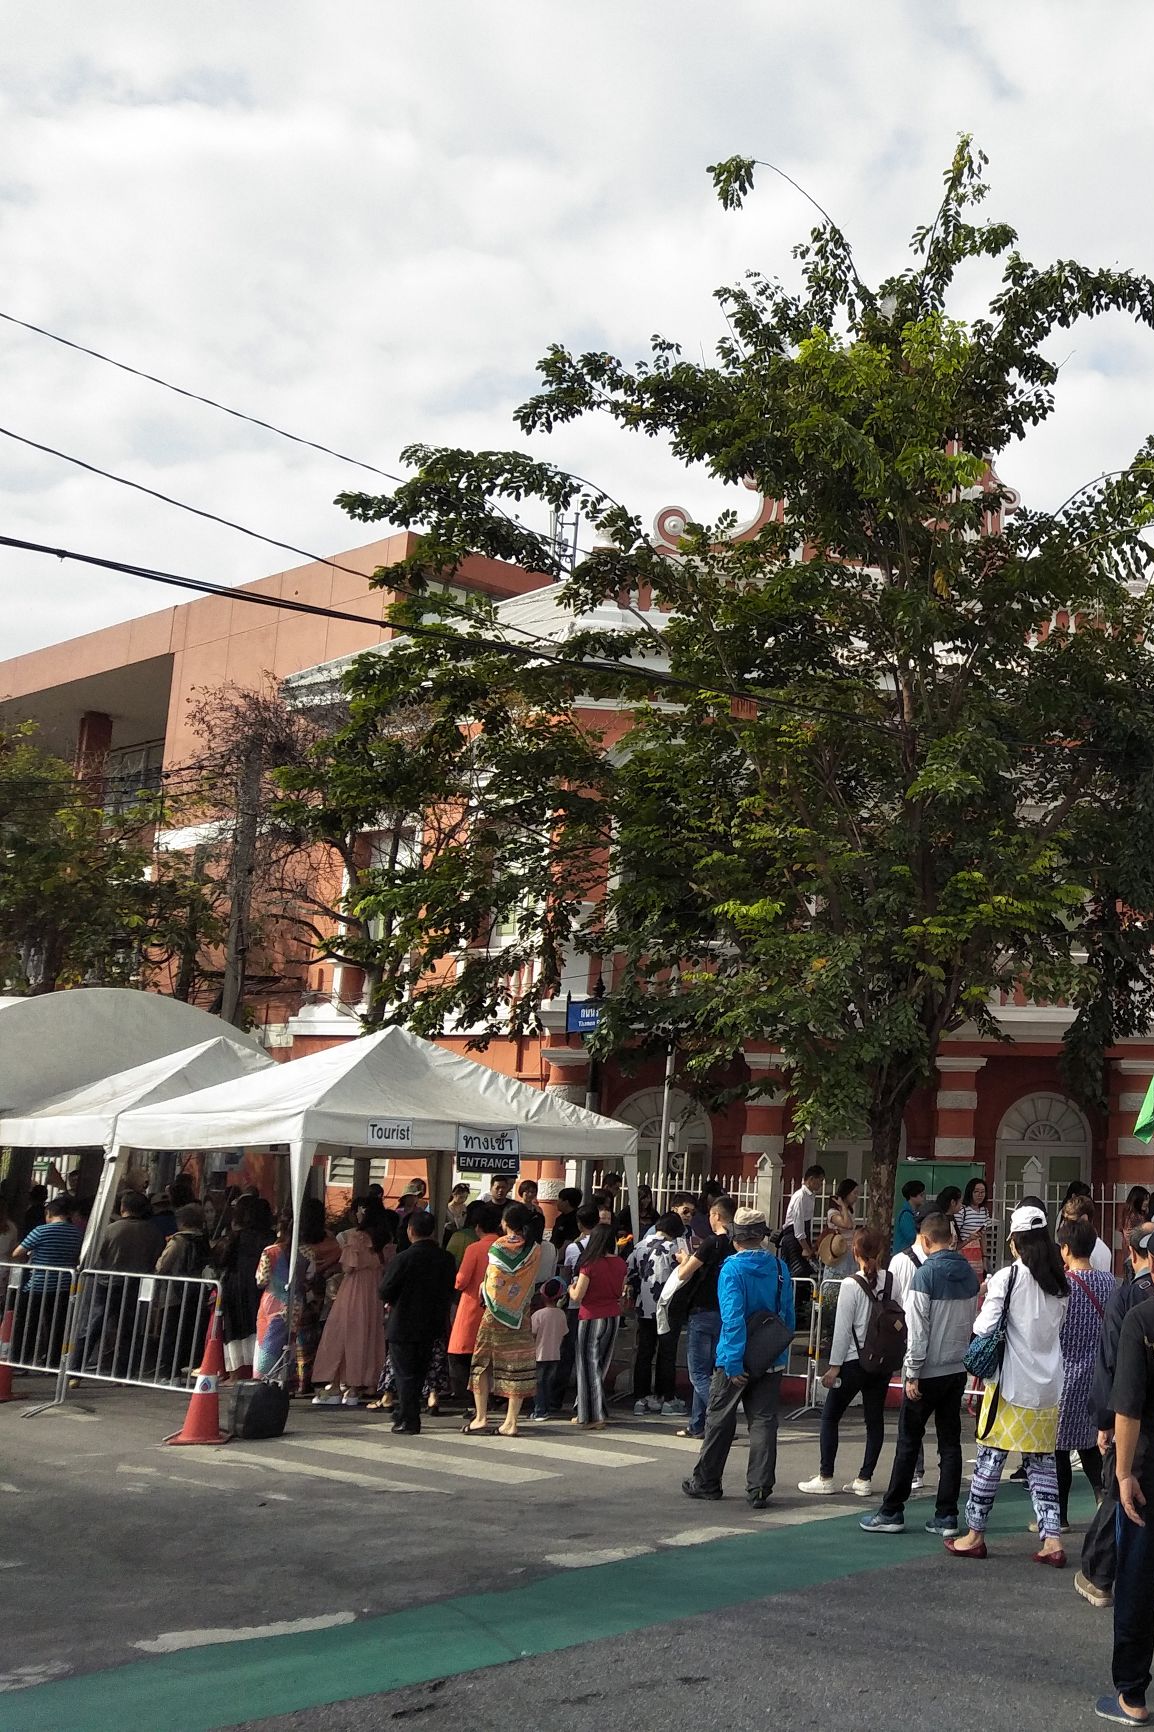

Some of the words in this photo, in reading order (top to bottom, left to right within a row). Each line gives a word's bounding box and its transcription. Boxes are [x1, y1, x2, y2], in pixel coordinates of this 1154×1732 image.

[369, 1123, 411, 1141] Tourist
[463, 1132, 513, 1151] ทางเข้า
[459, 1157, 516, 1169] ENTRANCE
